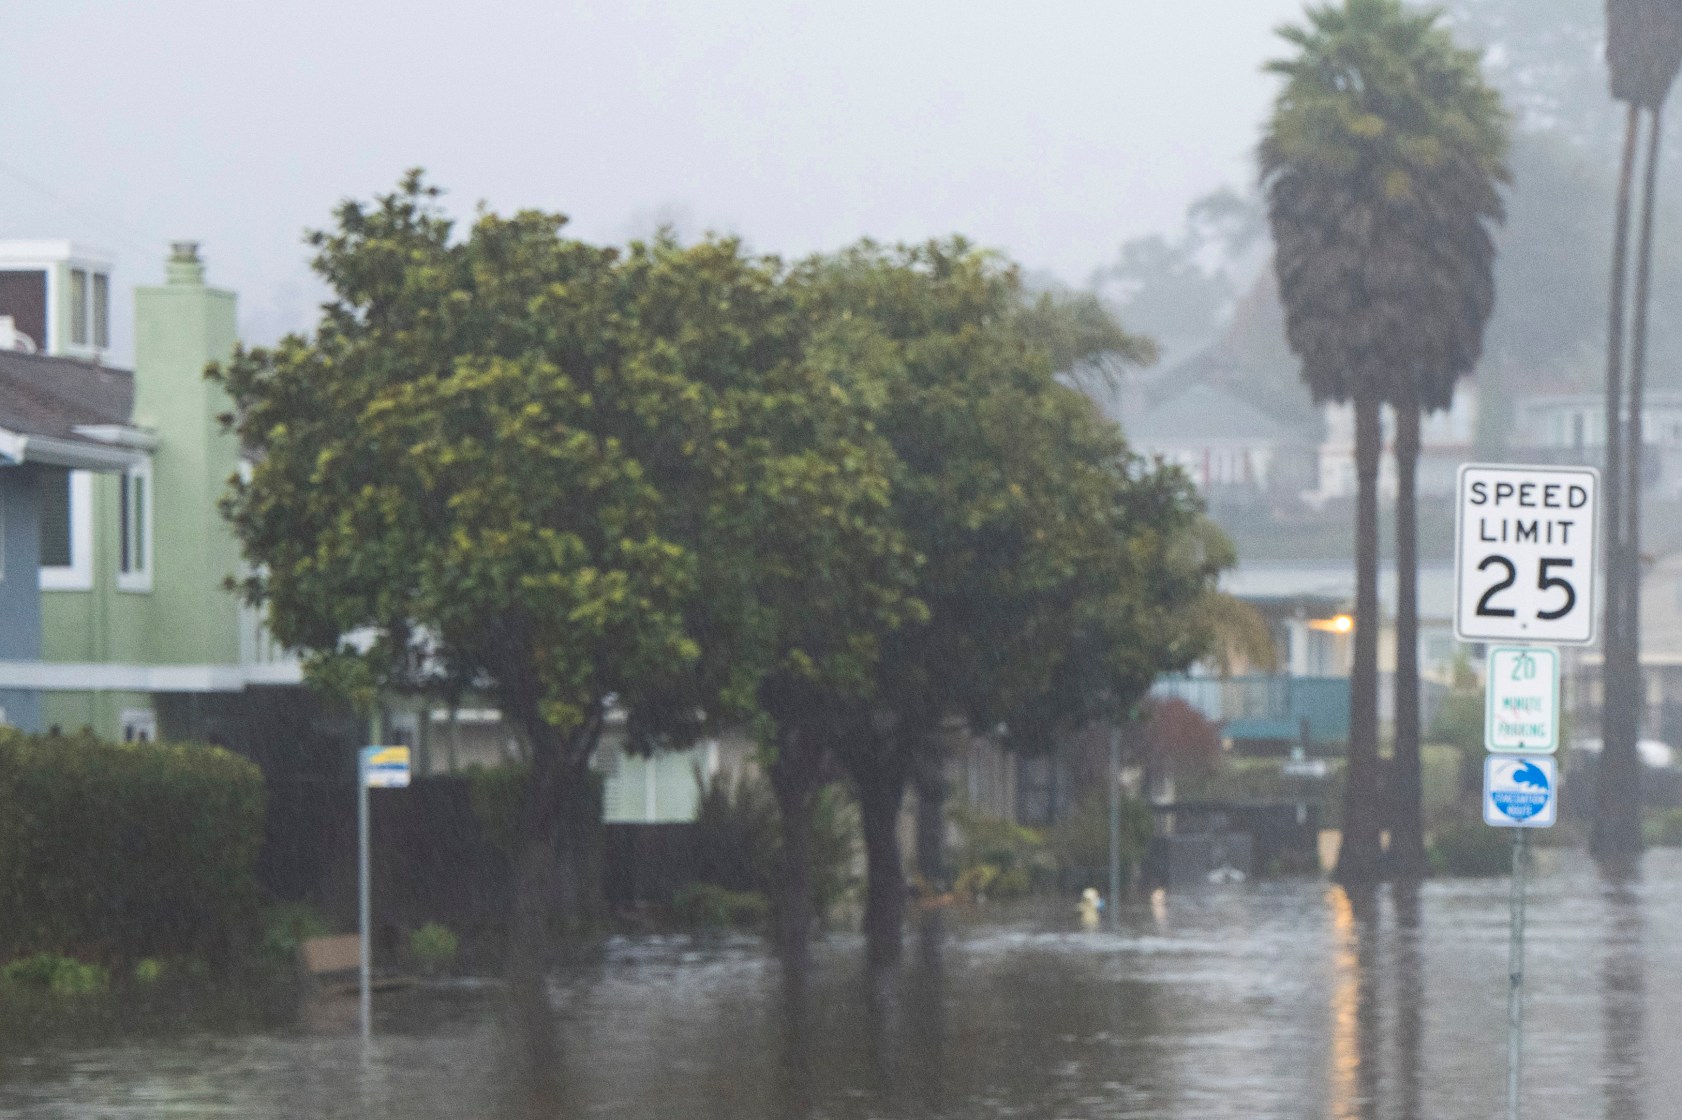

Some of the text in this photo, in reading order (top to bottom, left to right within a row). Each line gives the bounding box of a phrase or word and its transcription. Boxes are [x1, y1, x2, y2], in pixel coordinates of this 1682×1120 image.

[1470, 481, 1588, 509] SPEED
[1480, 518, 1575, 545] LIMIT
[1475, 554, 1577, 621] 25
[1511, 655, 1537, 681] 20
